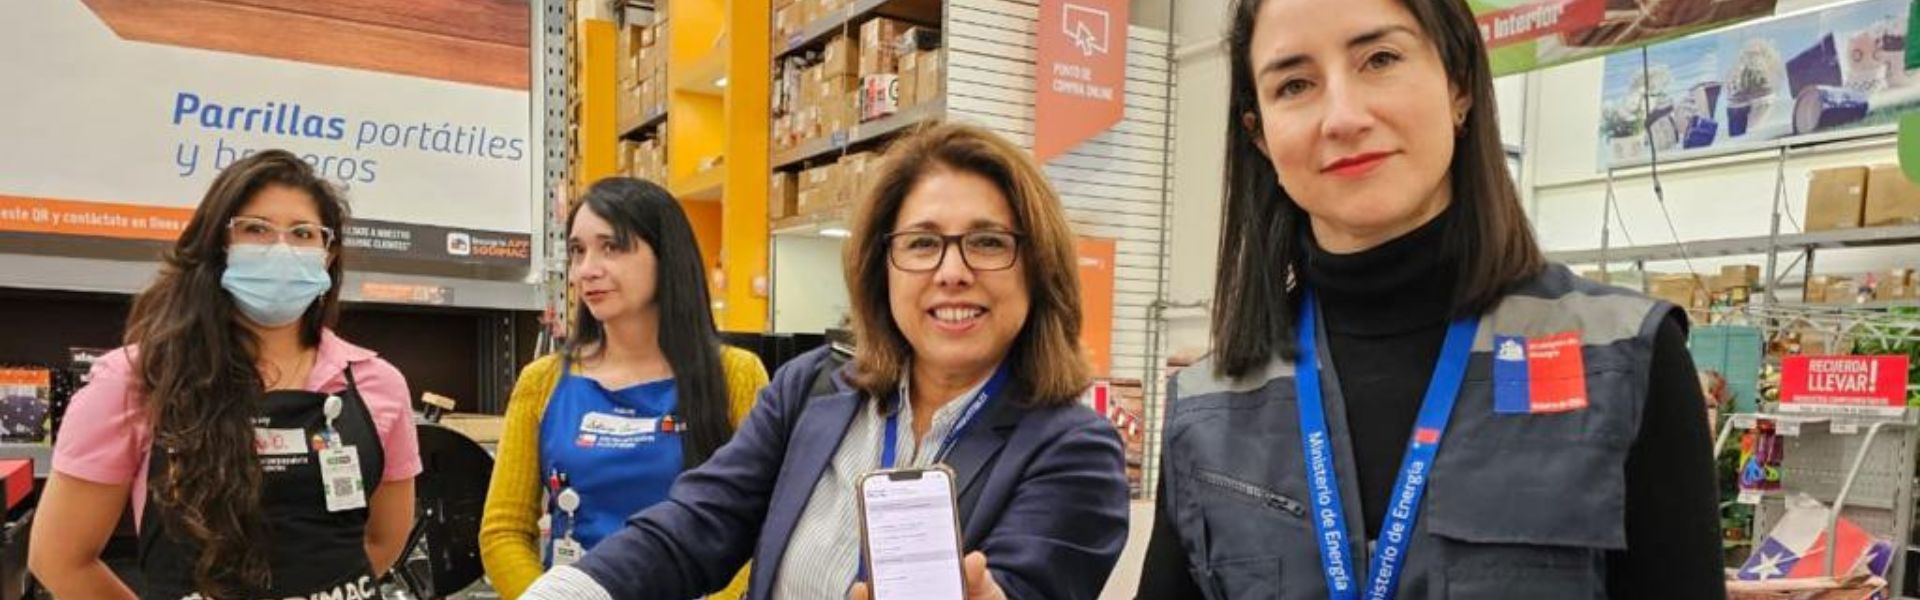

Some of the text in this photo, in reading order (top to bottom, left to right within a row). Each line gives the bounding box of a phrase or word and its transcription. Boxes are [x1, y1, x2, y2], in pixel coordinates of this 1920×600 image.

[1493, 5, 1559, 39] Interior
[173, 92, 525, 161] Parrillas portátiles
[176, 141, 199, 177] y
[32, 206, 49, 222] QR
[52, 213, 61, 226] y
[1808, 359, 1868, 374] RECUERDA
[1392, 460, 1425, 520] Energía
[1308, 430, 1349, 591] Ministerio de Energía
[1387, 521, 1405, 543] de
